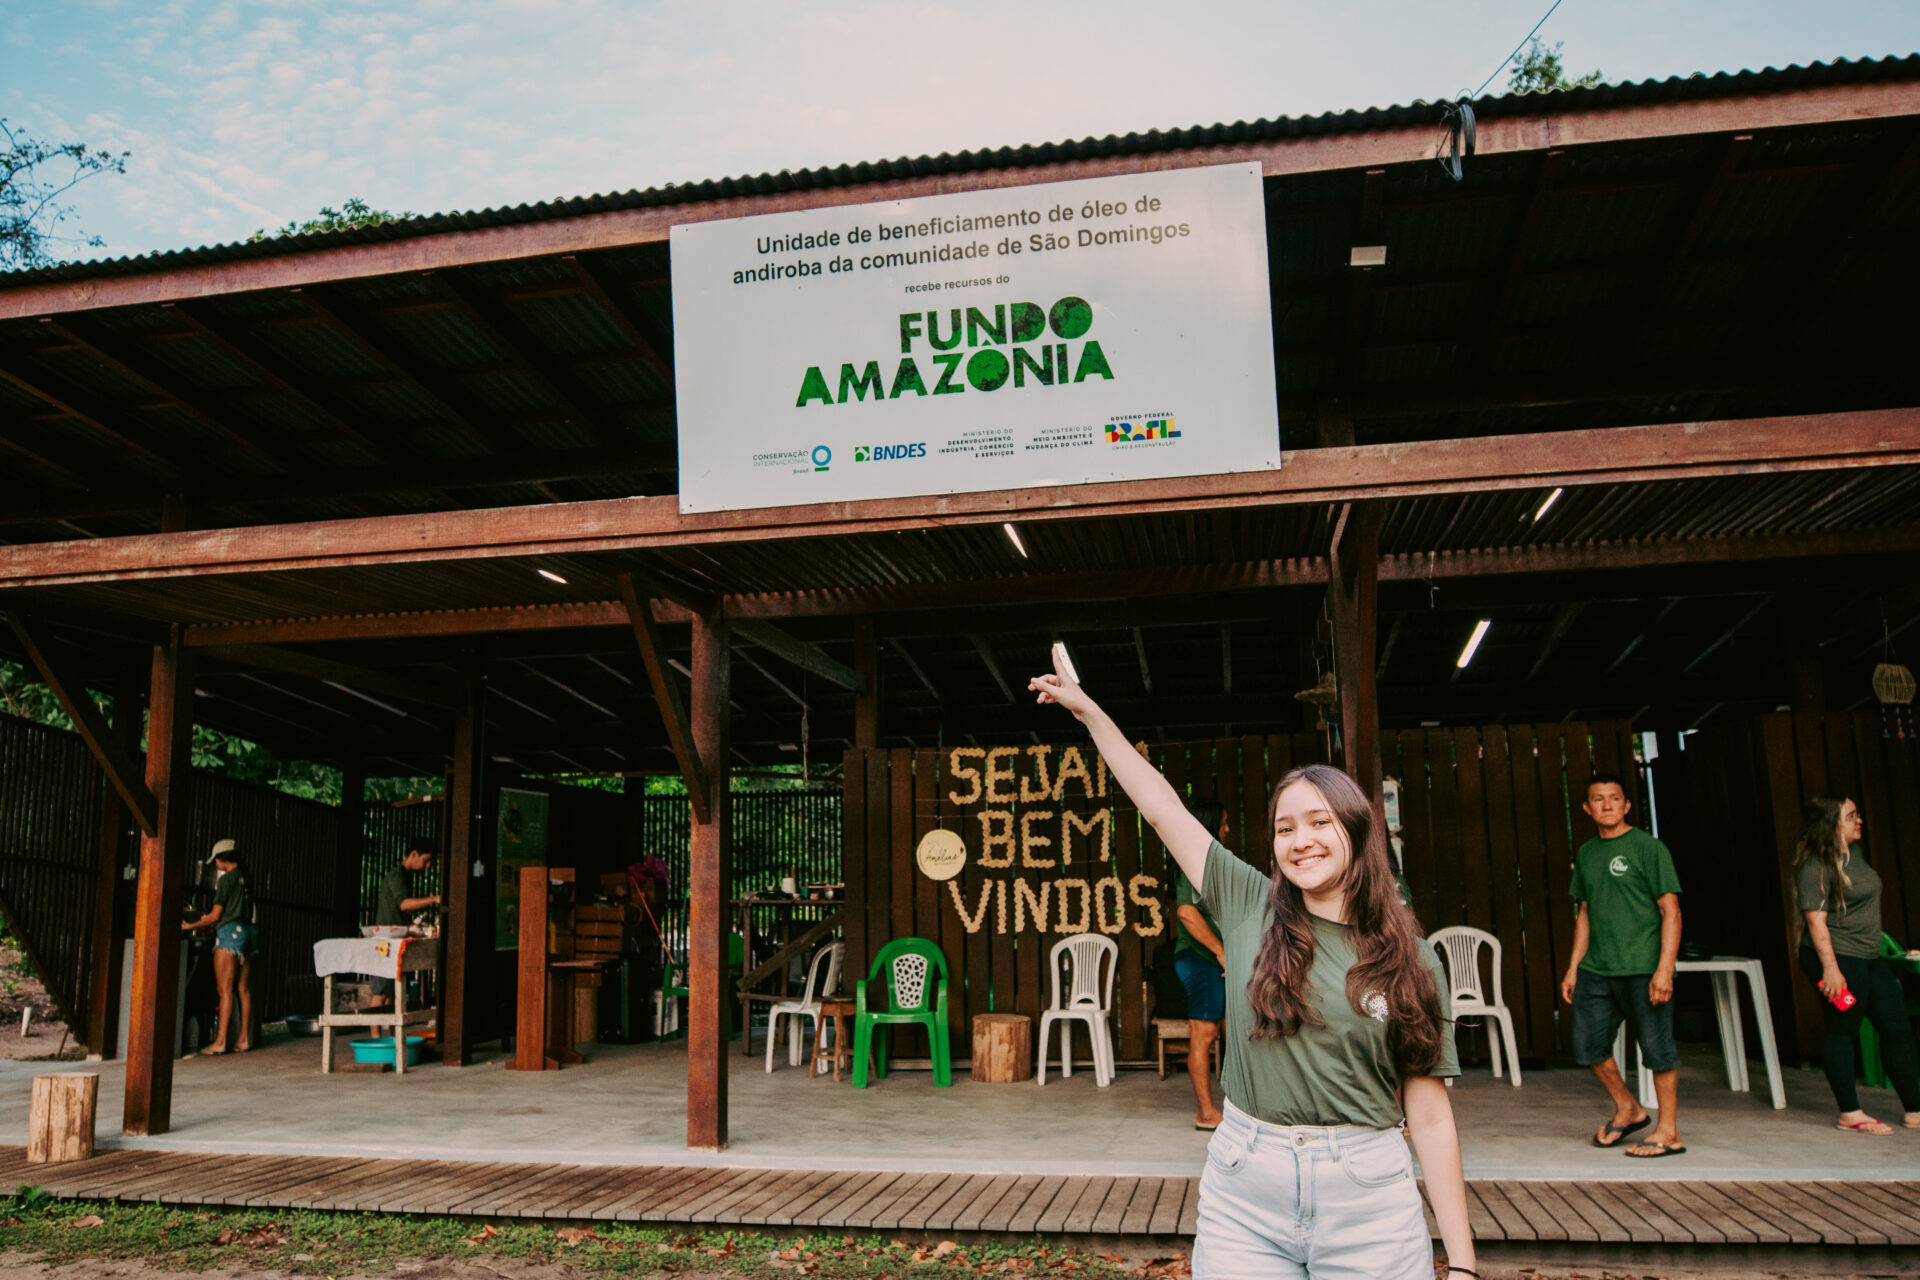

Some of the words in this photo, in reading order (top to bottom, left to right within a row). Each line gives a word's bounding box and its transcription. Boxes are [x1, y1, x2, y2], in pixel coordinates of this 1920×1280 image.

[757, 230, 840, 254] Unidade
[848, 226, 872, 243] de
[879, 209, 1041, 241] beneficiamento
[1049, 204, 1074, 223] de
[1081, 200, 1128, 219] óleo
[1135, 195, 1161, 213] de
[733, 260, 822, 284] andiroba
[829, 256, 853, 273] da
[860, 241, 989, 270] comunidade
[997, 237, 1022, 255] de
[1029, 233, 1070, 252] São
[1078, 223, 1191, 247] Domingos
[905, 279, 941, 293] recebe
[944, 276, 992, 290] recursos
[996, 274, 1010, 285] do
[900, 296, 1093, 353] FUNDO
[796, 339, 1115, 407] AMAZÔNIA
[1052, 433, 1087, 441] AMBIENTE
[1105, 418, 1181, 443] BRASIL
[753, 450, 809, 461] CONSERVAÇÃO
[873, 442, 926, 461] BNDES
[1025, 442, 1058, 450] MUDANÇA
[753, 457, 809, 467] INTERNACIONAL
[977, 808, 1111, 869] BEM
[948, 874, 1164, 937] VINDOS
